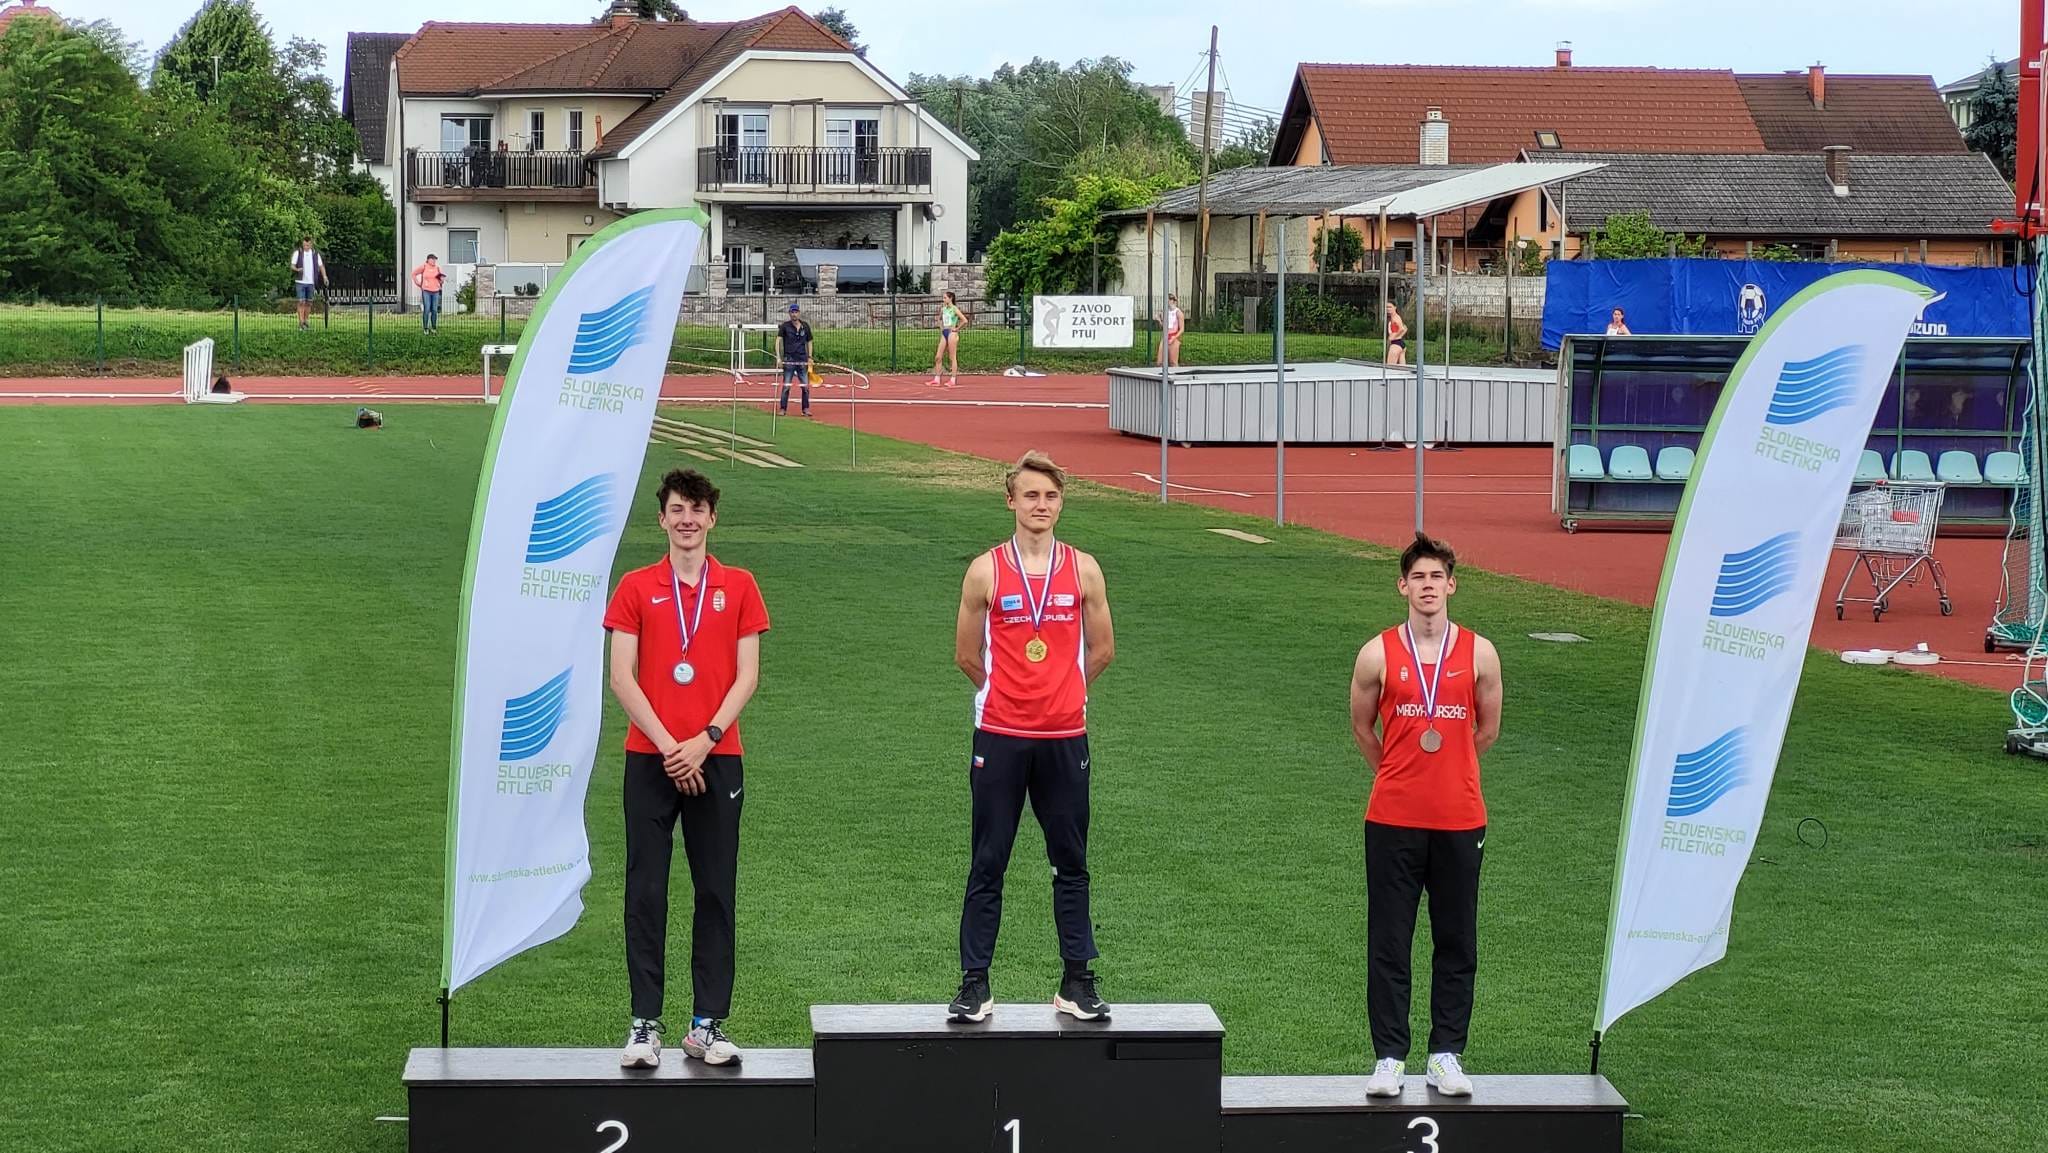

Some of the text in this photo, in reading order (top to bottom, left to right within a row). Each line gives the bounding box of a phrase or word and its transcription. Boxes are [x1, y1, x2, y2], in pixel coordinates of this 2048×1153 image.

[1072, 304, 1112, 313] ZAVOD
[1072, 315, 1126, 326] ZA ŠPORT
[1910, 322, 1948, 336] IZUNO
[1072, 329, 1096, 340] PTUJ
[1759, 425, 1841, 463] SLOVENSKA
[1754, 441, 1823, 473] ATLETIKA
[520, 582, 592, 602] ATLETIKA
[1705, 619, 1785, 650] SLOVENSKA
[1703, 635, 1766, 660] ATLETIKA
[1396, 703, 1467, 720] MAGYARSZÁG
[497, 764, 572, 780] SLOVESKA
[1663, 820, 1746, 844] SLOVENSKA
[1661, 836, 1726, 857] ATLETIKA
[596, 1120, 629, 1153] 2
[1003, 1119, 1020, 1153] 1
[1407, 1116, 1439, 1153] 3
